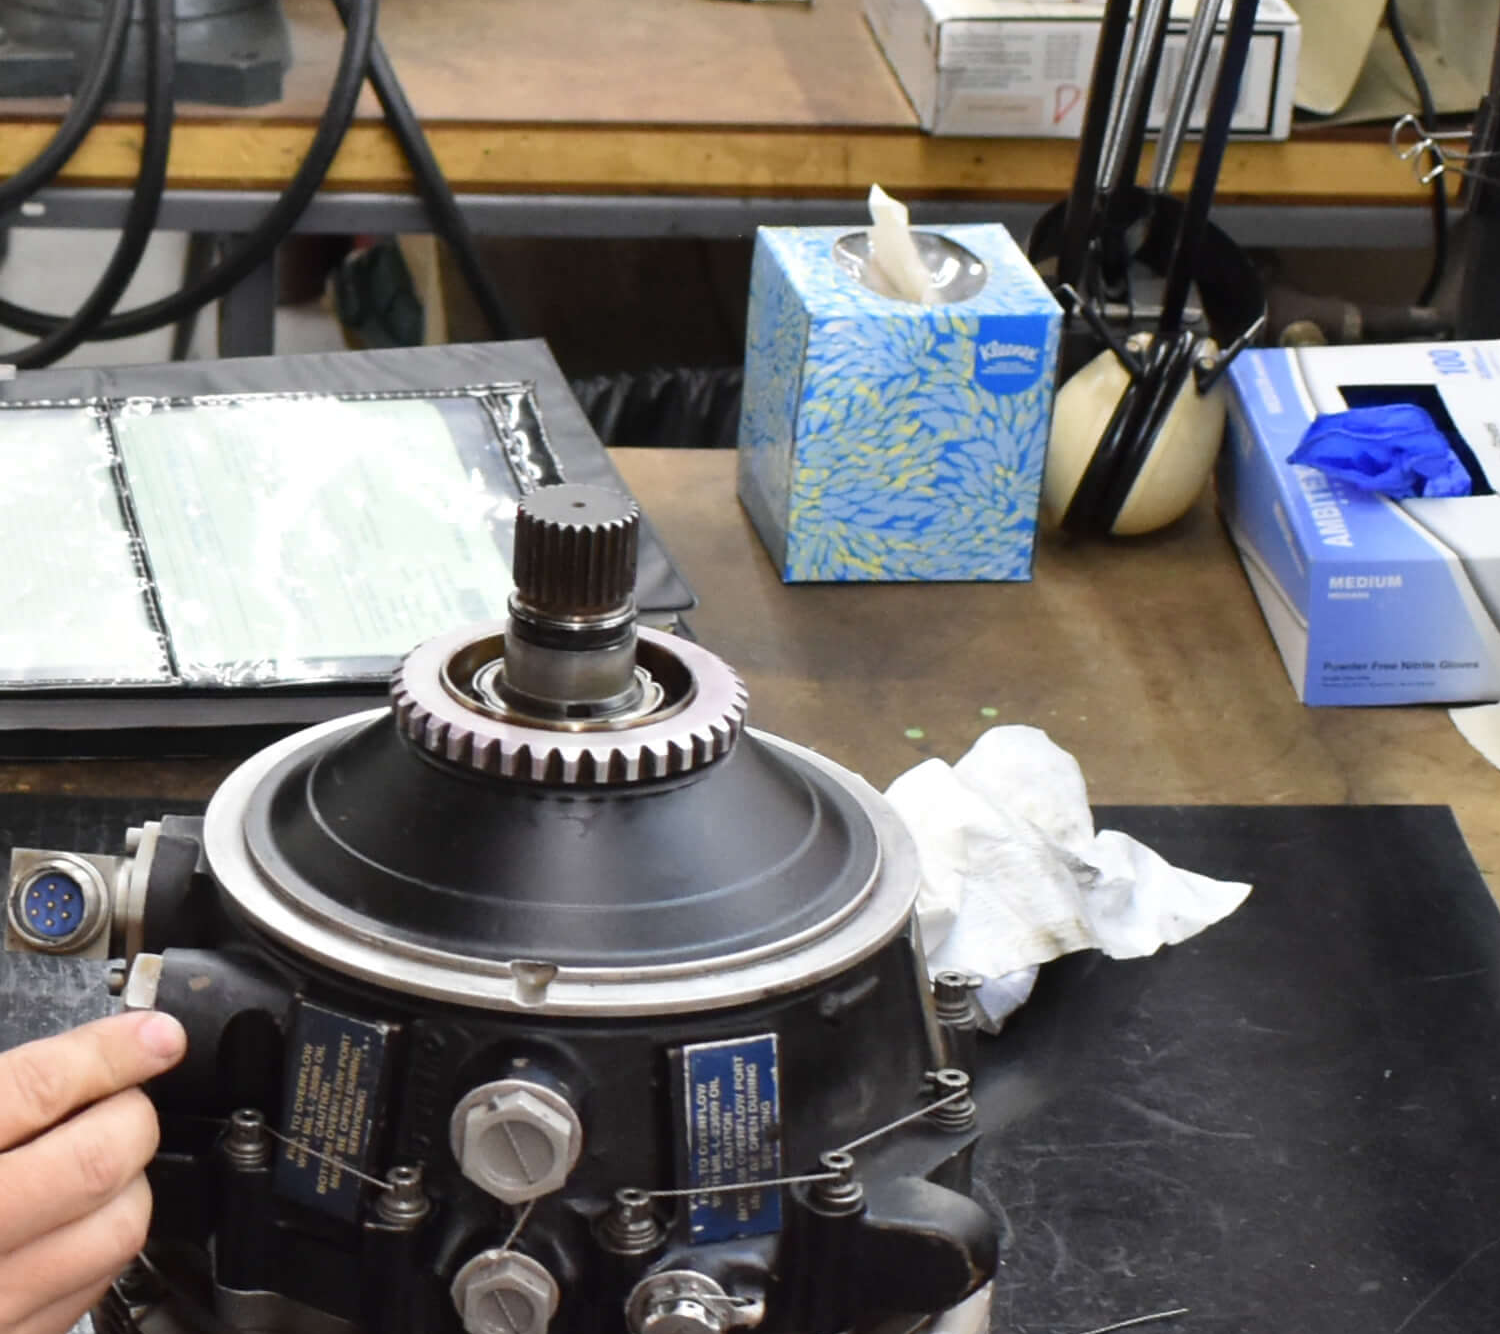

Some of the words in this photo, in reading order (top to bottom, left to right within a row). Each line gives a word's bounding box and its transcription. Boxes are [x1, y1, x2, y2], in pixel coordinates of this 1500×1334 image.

[1428, 349, 1468, 376] 100
[1328, 574, 1403, 589] MEDIUM
[1323, 660, 1369, 671] Powder
[1371, 660, 1398, 670] Free
[1401, 660, 1436, 670] Nitrile
[1439, 659, 1479, 669] Gloves
[315, 1044, 326, 1063] OIL
[345, 1047, 360, 1095] DURING
[294, 1043, 313, 1113] OVERFLOW
[326, 1070, 344, 1140] OVERFLOW
[338, 1032, 351, 1068] PORT
[709, 1077, 720, 1098] OIL
[732, 1055, 745, 1090] PORT
[746, 1063, 758, 1113] DURING
[290, 1115, 302, 1130] TO
[315, 1082, 332, 1137] CAUTION
[340, 1096, 353, 1132] OPEN
[348, 1088, 367, 1155] SERVICING
[696, 1083, 709, 1156] OVERFLOW
[336, 1135, 347, 1152] BE
[723, 1111, 734, 1169] CAUTION
[734, 1093, 746, 1165] OVERFLOW
[748, 1116, 760, 1151] OPEN
[698, 1158, 708, 1175] TO
